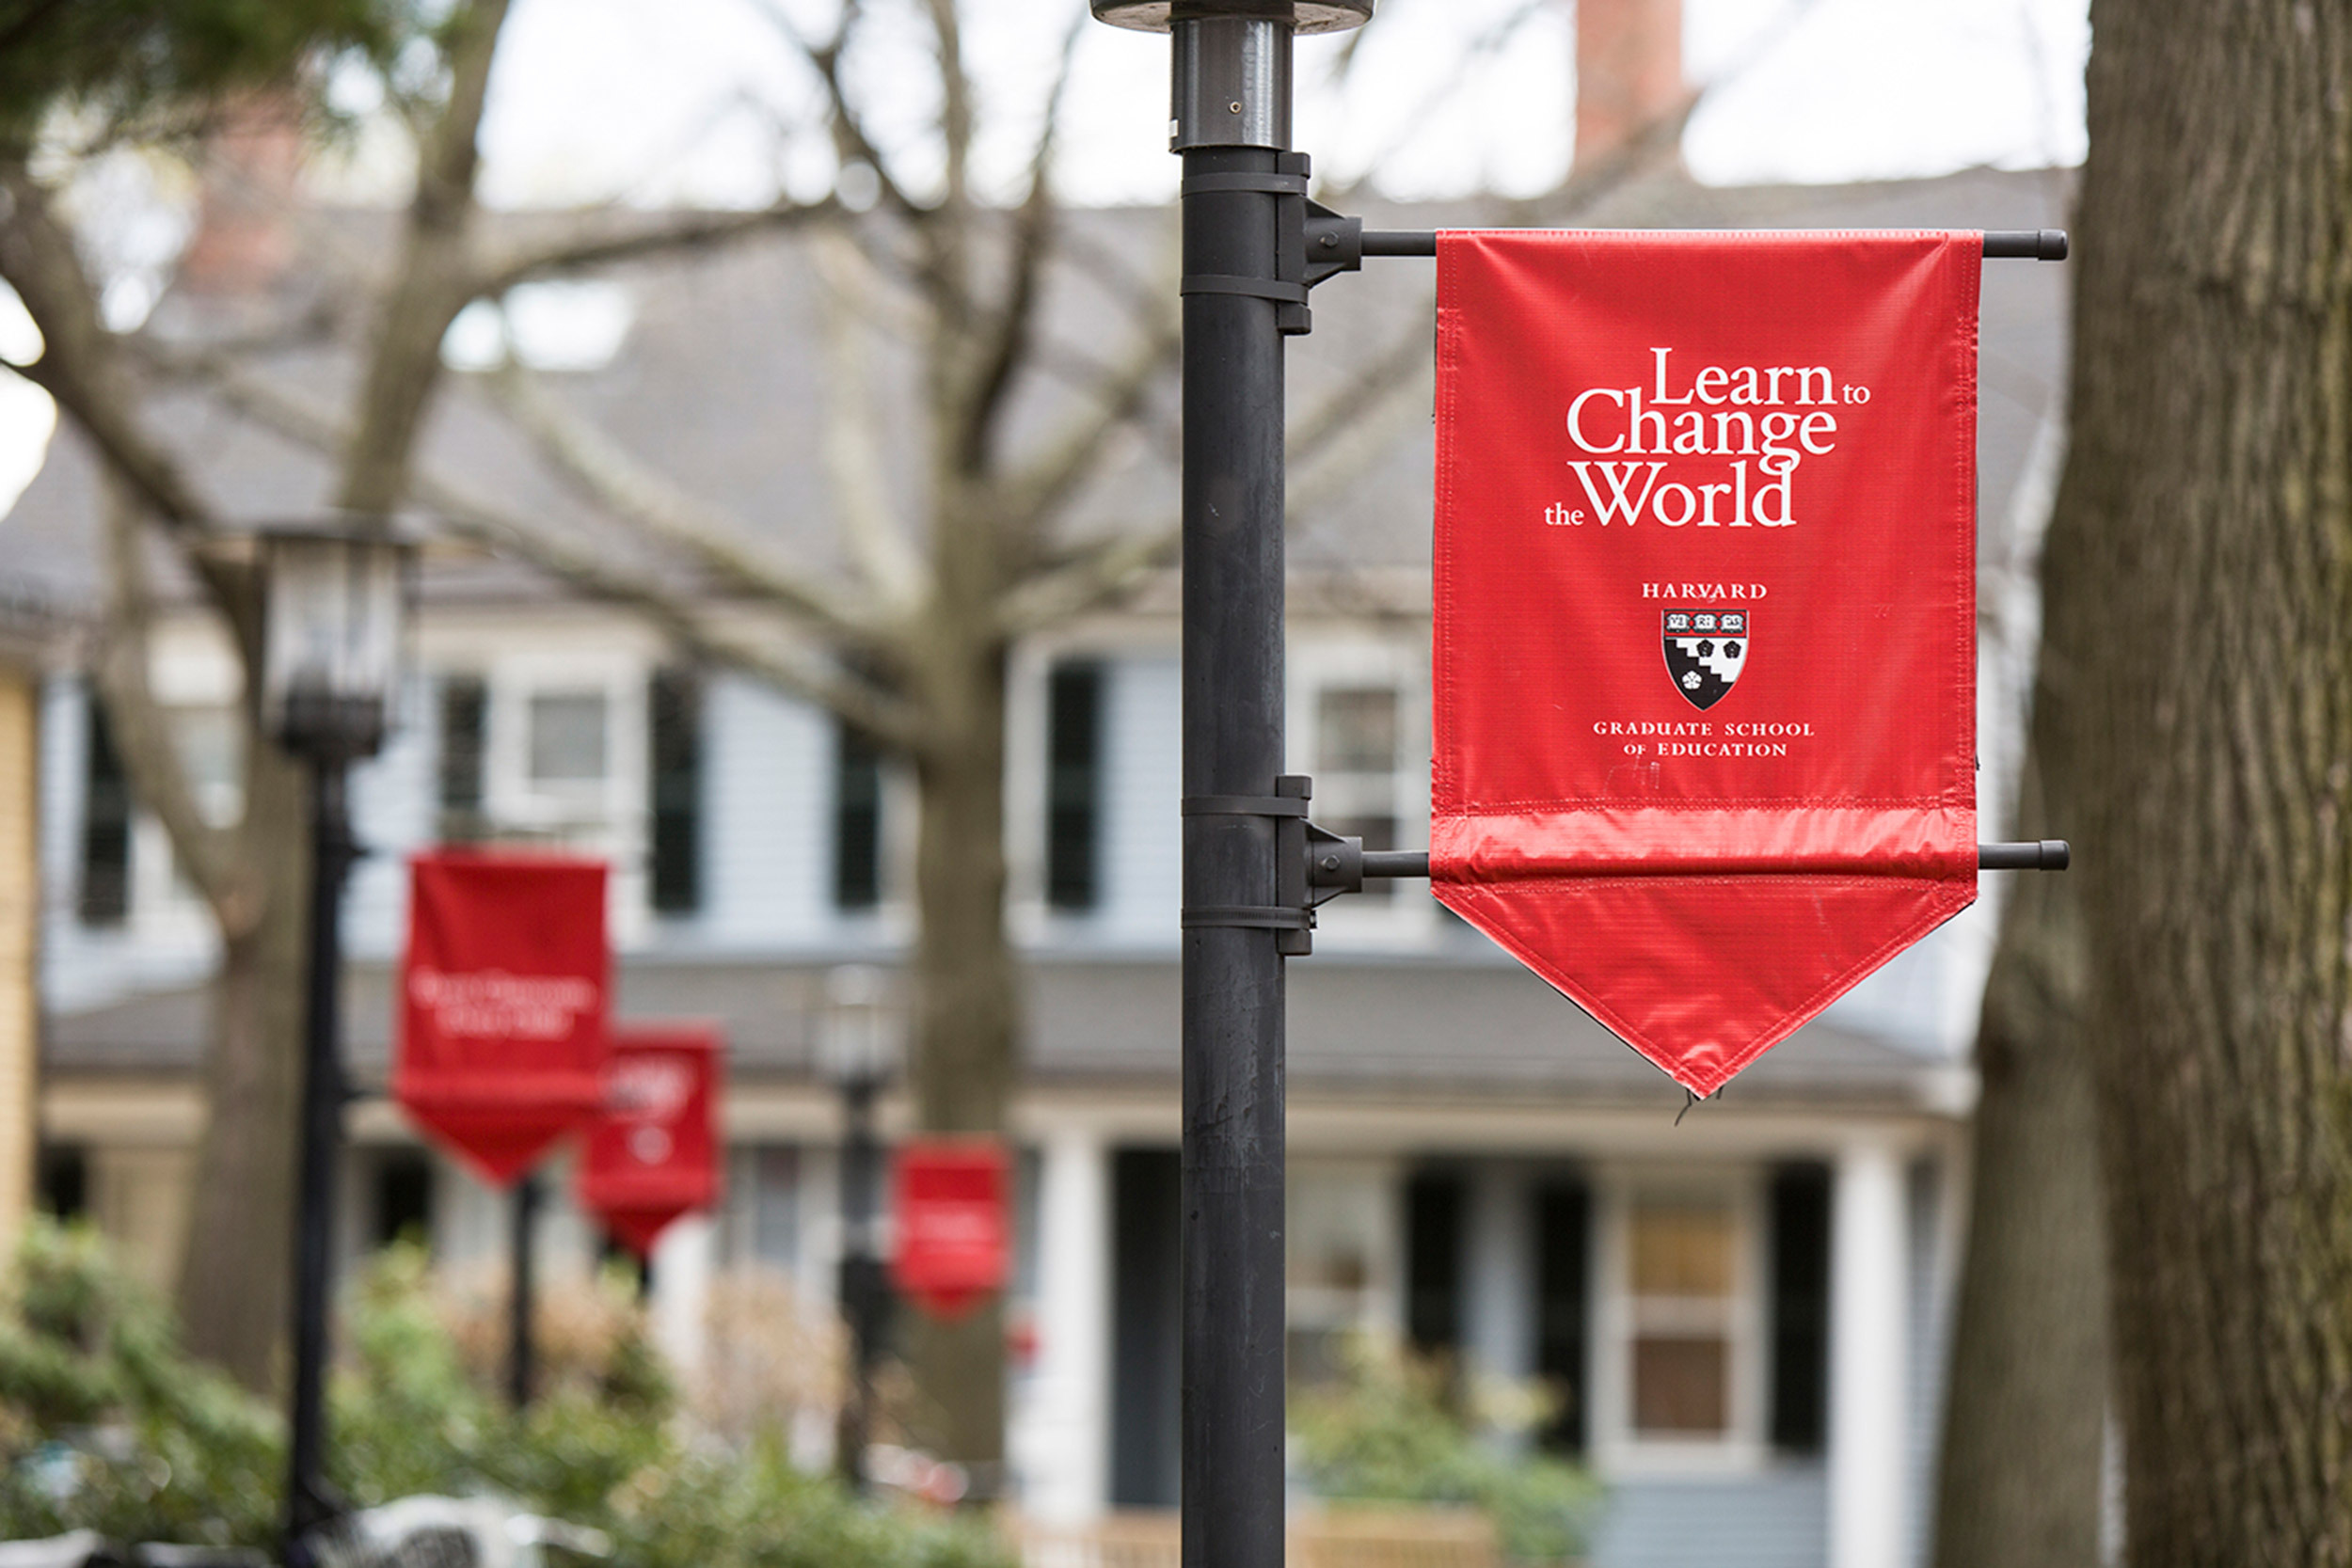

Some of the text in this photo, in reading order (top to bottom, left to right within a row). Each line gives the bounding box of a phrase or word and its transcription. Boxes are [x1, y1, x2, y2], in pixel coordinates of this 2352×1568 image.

[1649, 347, 1871, 405] Learn to
[1565, 387, 1837, 476] Change
[1543, 460, 1797, 527] the World
[1642, 582, 1768, 599] HARVARD
[1593, 721, 1815, 736] GRADUATE SCHOOL
[1623, 742, 1788, 756] OF EDUCATION
